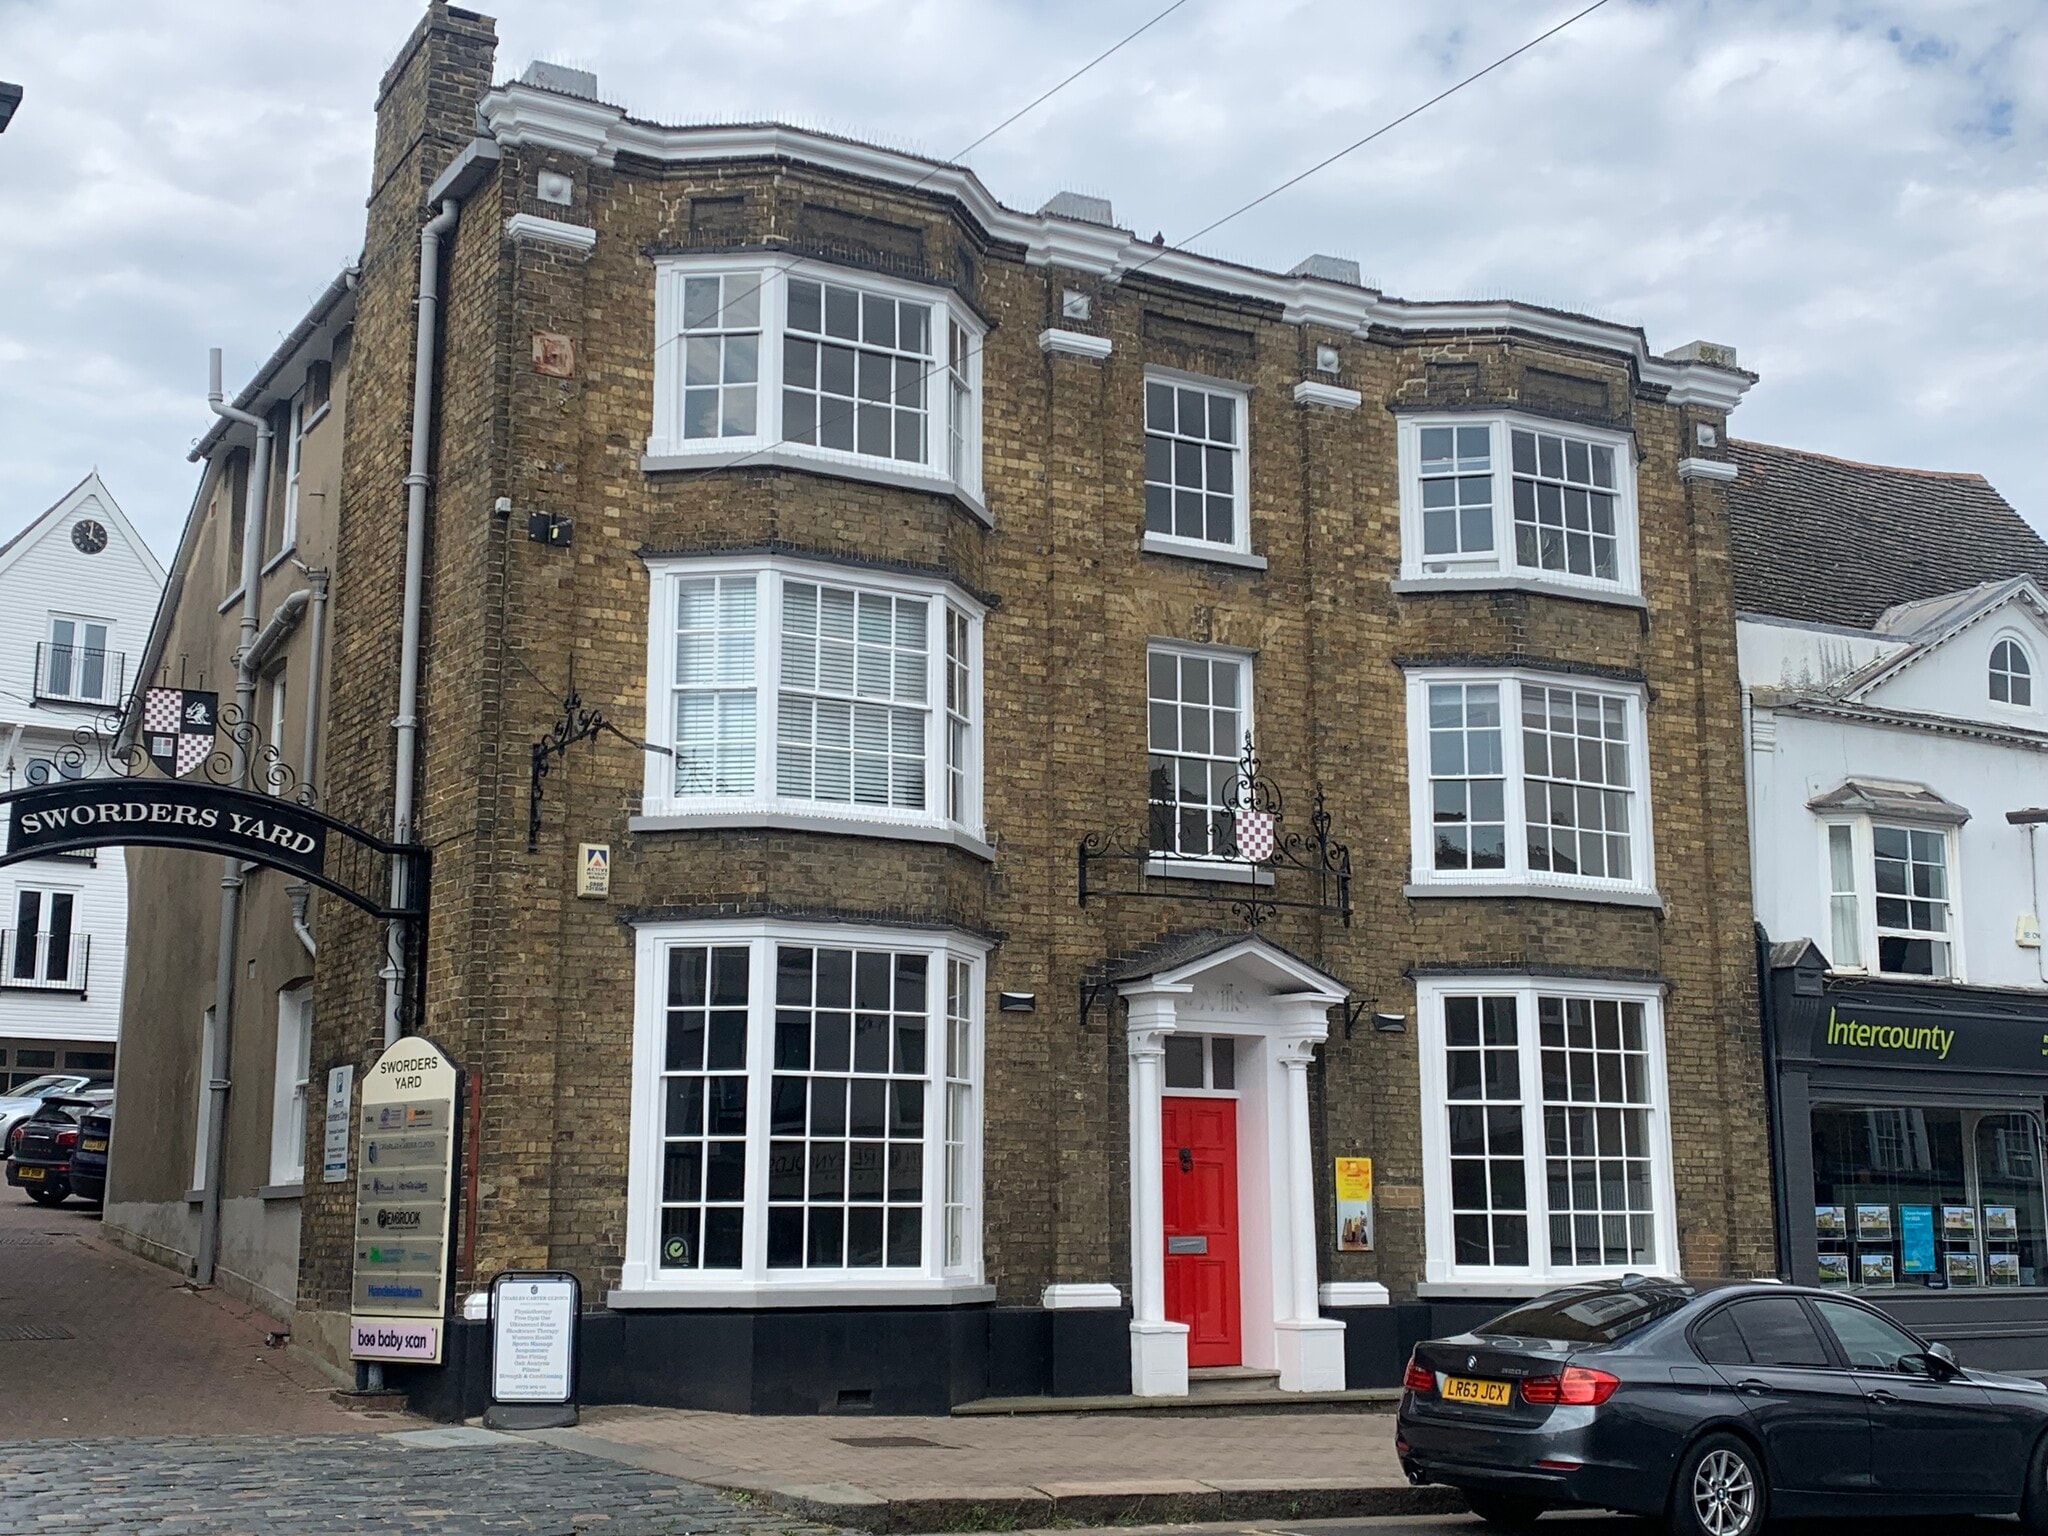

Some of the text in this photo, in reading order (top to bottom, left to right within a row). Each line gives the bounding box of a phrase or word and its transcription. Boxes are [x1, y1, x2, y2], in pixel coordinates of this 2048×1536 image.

[20, 803, 316, 854] SWORDERS YARD
[1827, 1006, 1955, 1060] Intercounty
[380, 1056, 438, 1074] SWORDERS
[395, 1075, 422, 1090] YARD
[377, 1209, 421, 1228] PEMBROOK
[358, 1329, 427, 1351] boo baby scan
[1448, 1381, 1505, 1401] LR63 JCX
